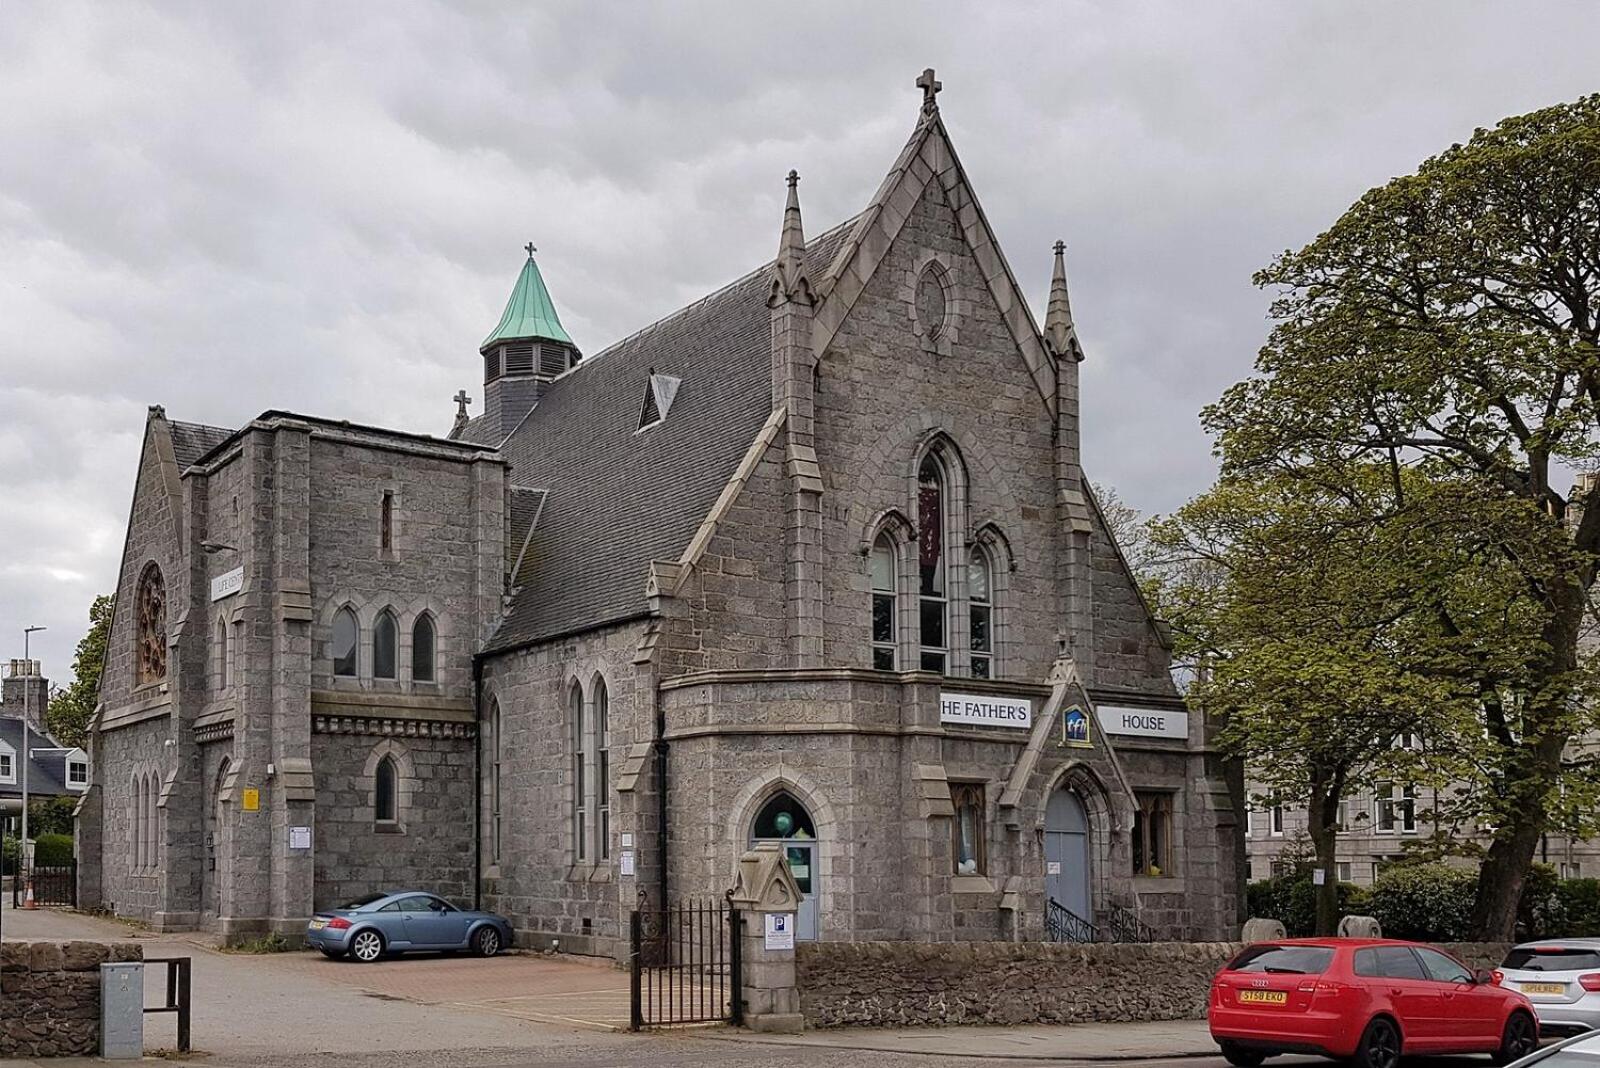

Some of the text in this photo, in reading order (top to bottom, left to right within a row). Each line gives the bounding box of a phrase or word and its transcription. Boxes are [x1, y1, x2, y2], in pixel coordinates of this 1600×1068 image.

[940, 700, 1027, 720] HE FATHER'S
[1122, 714, 1166, 731] HOUSE
[776, 917, 784, 930] P
